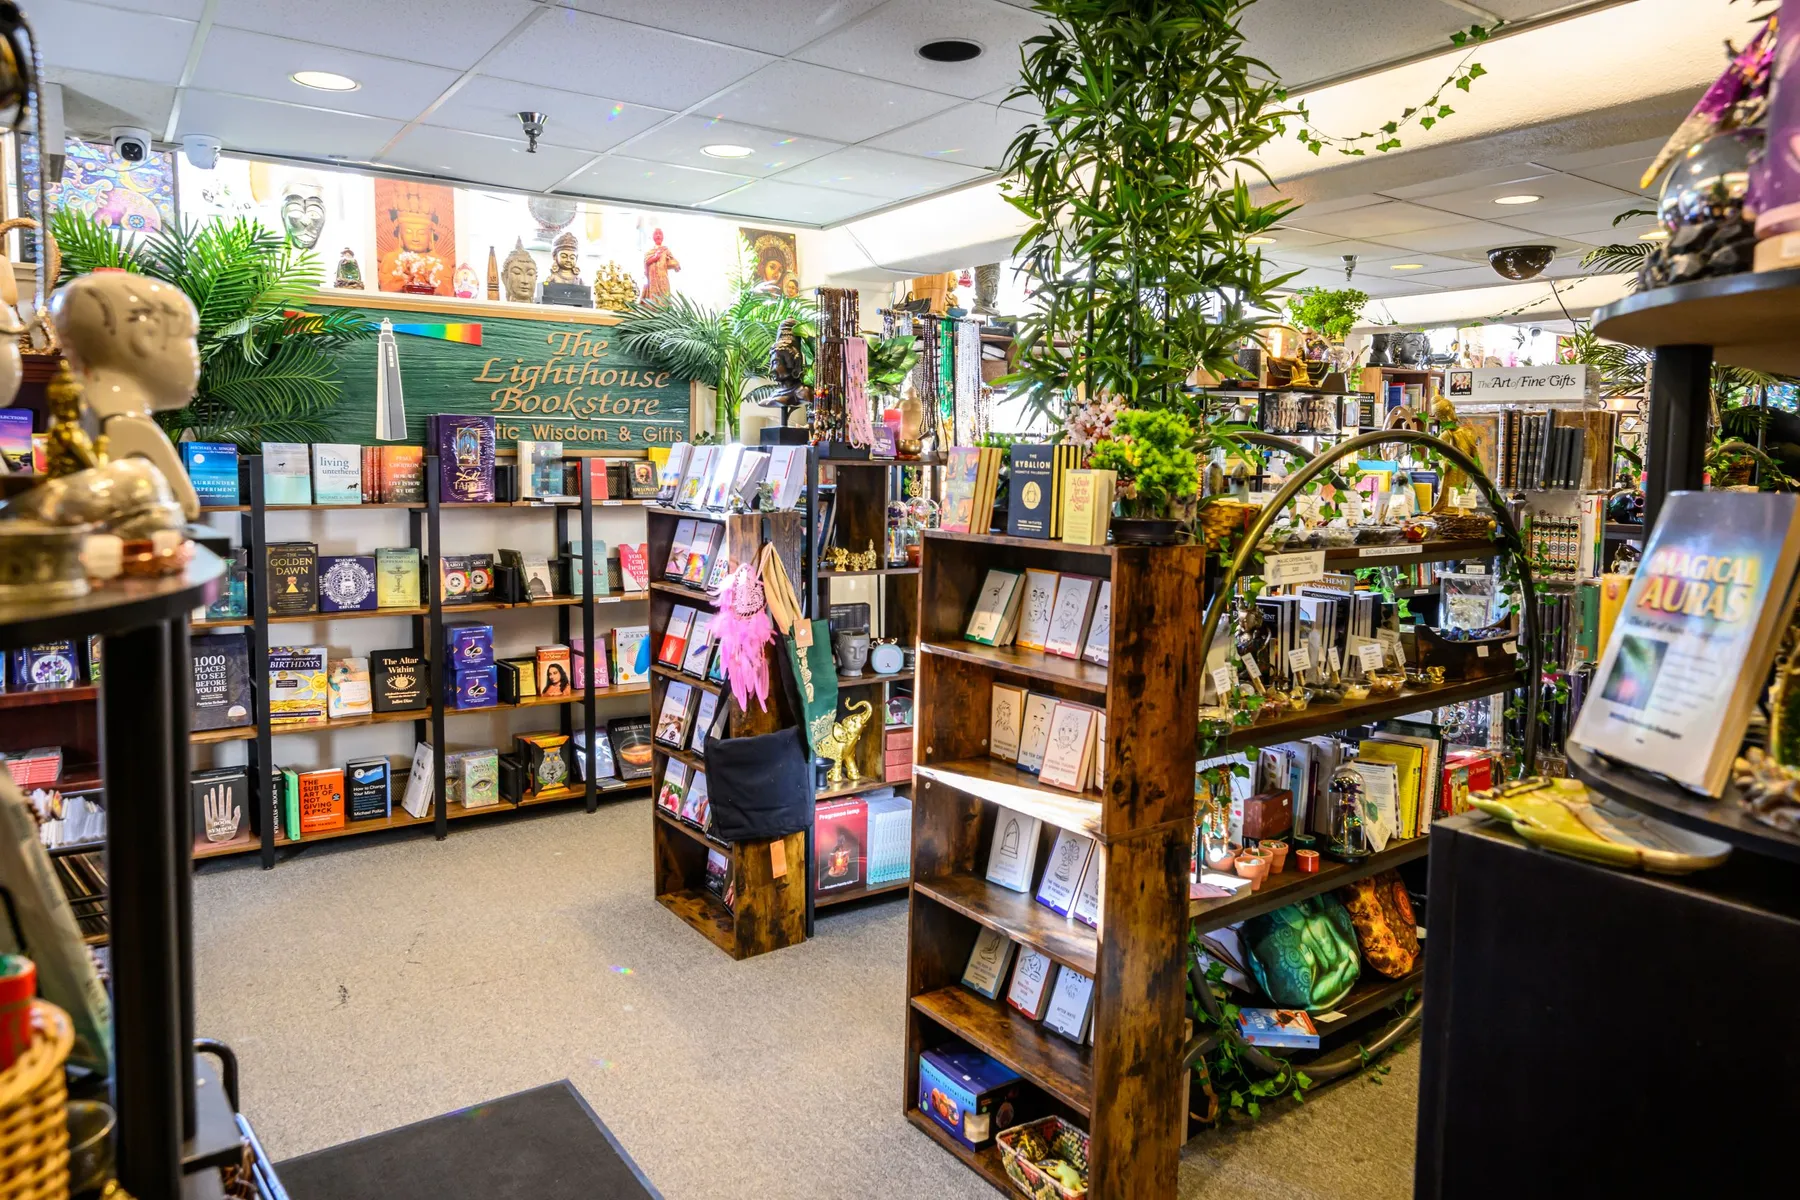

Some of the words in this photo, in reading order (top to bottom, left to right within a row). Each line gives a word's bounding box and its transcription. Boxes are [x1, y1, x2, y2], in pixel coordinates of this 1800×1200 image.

[547, 329, 609, 358] The
[472, 357, 671, 396] Lighthouse
[1491, 376, 1511, 388] Art
[1520, 375, 1545, 388] Fine
[1547, 374, 1576, 389] Gifts
[490, 386, 661, 420] Bookstore
[495, 423, 520, 440] tic
[531, 424, 608, 442] Wisdom
[618, 426, 632, 442] &
[643, 426, 683, 442] Gifts
[320, 456, 349, 469] living
[1014, 460, 1050, 469] KYBALION
[270, 558, 312, 567] GOLDEN
[276, 566, 309, 576] DAWN
[1648, 550, 1760, 588] MAGICAL
[1314, 576, 1348, 586] LCHEMY
[1636, 575, 1750, 624] AURAS
[194, 655, 226, 666] 1000
[270, 660, 320, 668] BIRTHDAYS
[194, 665, 226, 674] PLACES
[388, 666, 414, 674] Within
[196, 680, 227, 688] BEFORE
[196, 686, 212, 694] YOU
[304, 784, 333, 792] SUBTLE
[304, 802, 332, 810] GIVING
